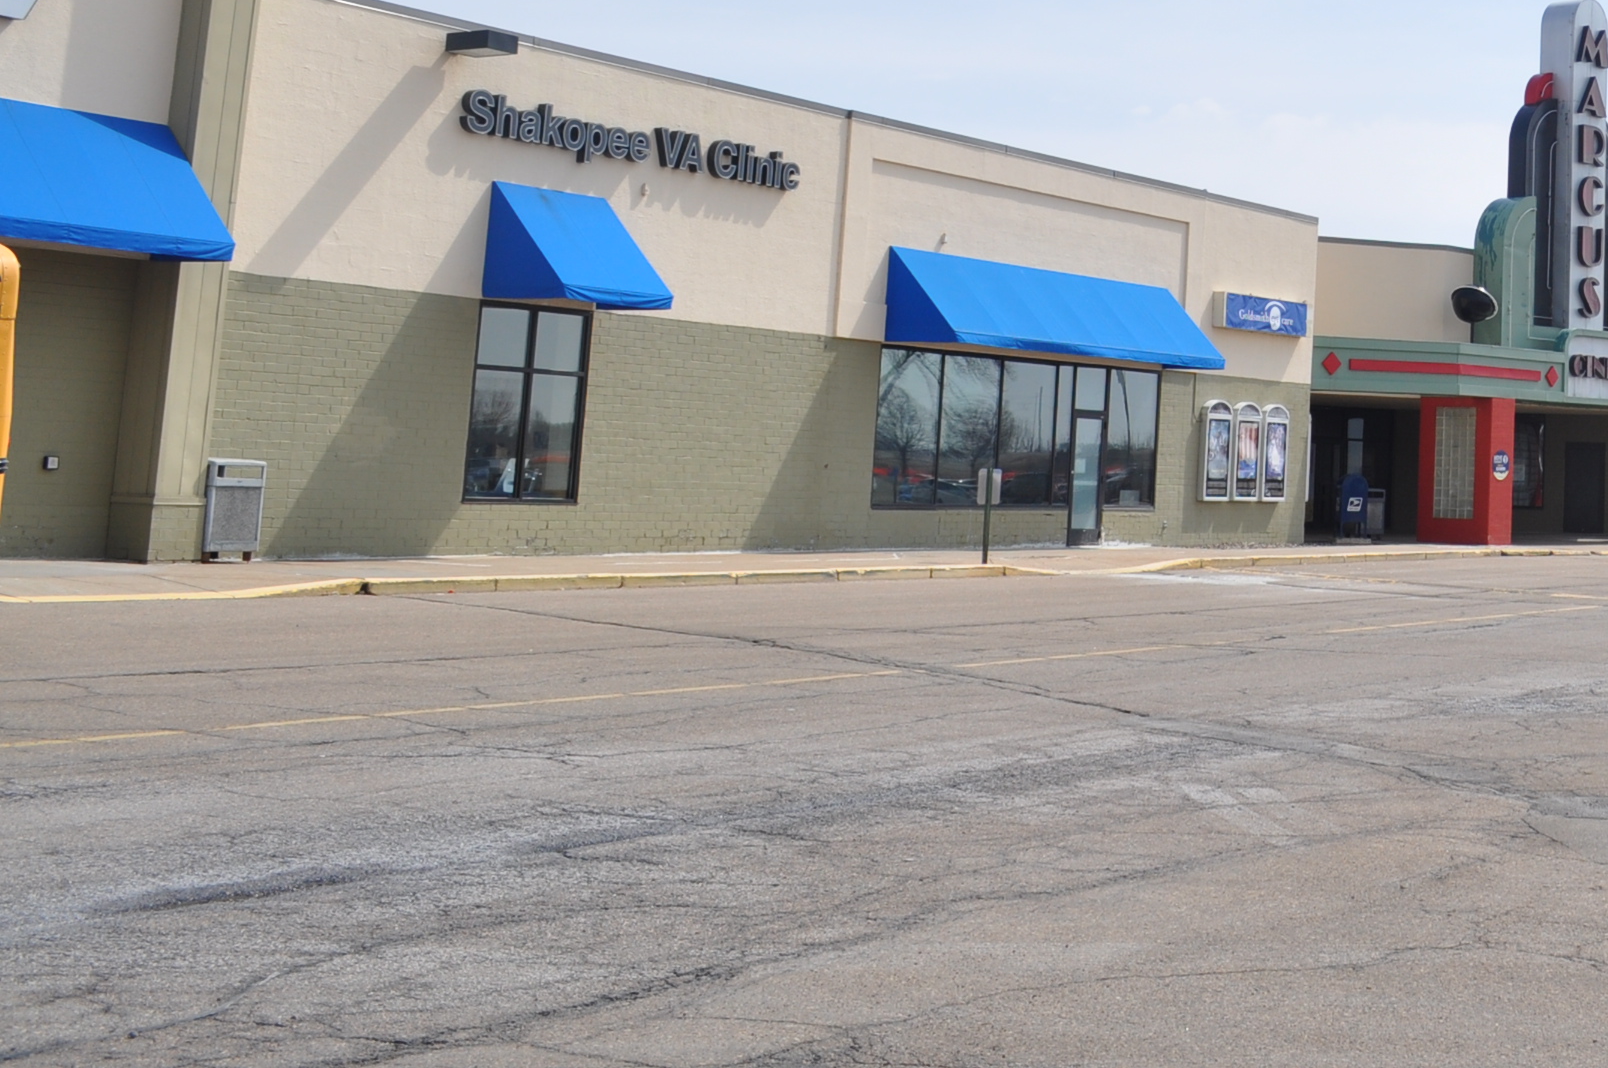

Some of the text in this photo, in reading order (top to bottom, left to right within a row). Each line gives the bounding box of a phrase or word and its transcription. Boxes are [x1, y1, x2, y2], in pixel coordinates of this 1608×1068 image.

[459, 89, 800, 191] Shakopee VA Clinic
[1281, 317, 1294, 326] care
